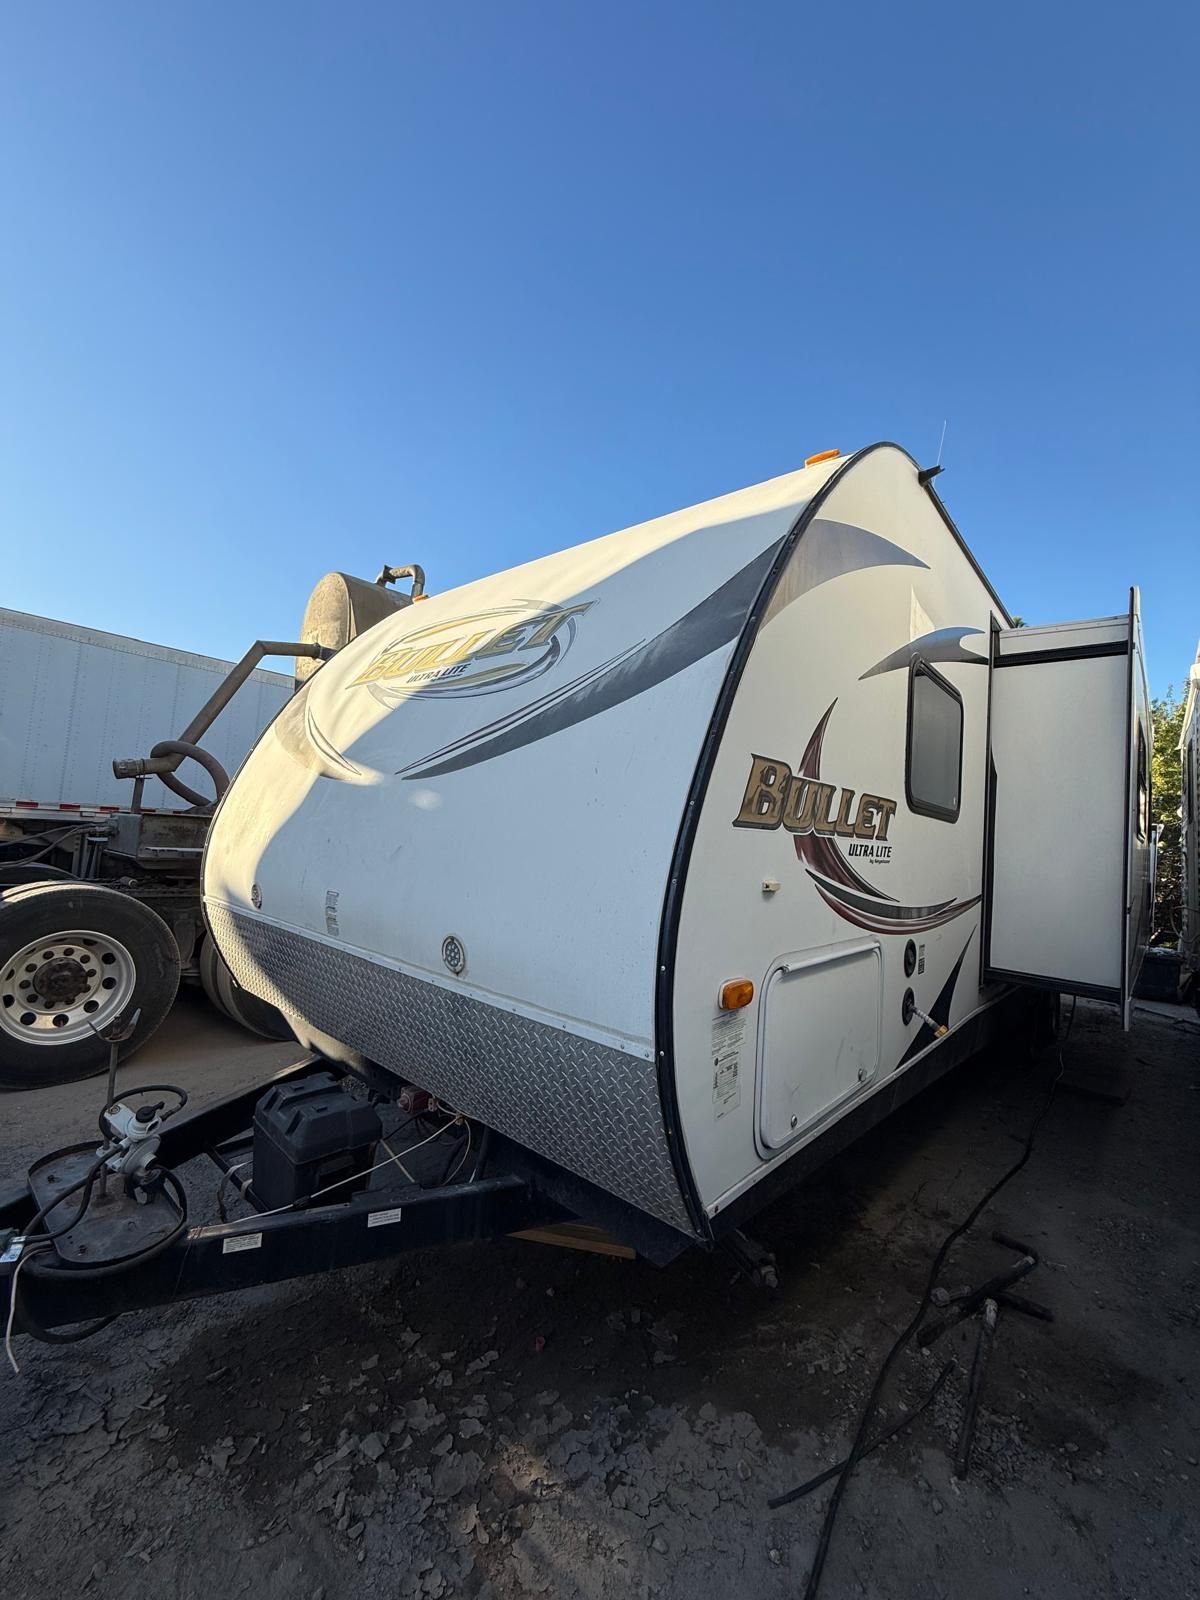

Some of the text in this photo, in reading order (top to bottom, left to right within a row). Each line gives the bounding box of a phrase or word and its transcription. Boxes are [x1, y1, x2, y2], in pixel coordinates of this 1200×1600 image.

[346, 601, 593, 688] BULLET
[406, 670, 441, 683] ULTRA
[441, 663, 471, 676] LITE
[733, 753, 897, 841] BULLET
[848, 843, 892, 858] ULTRA LITE
